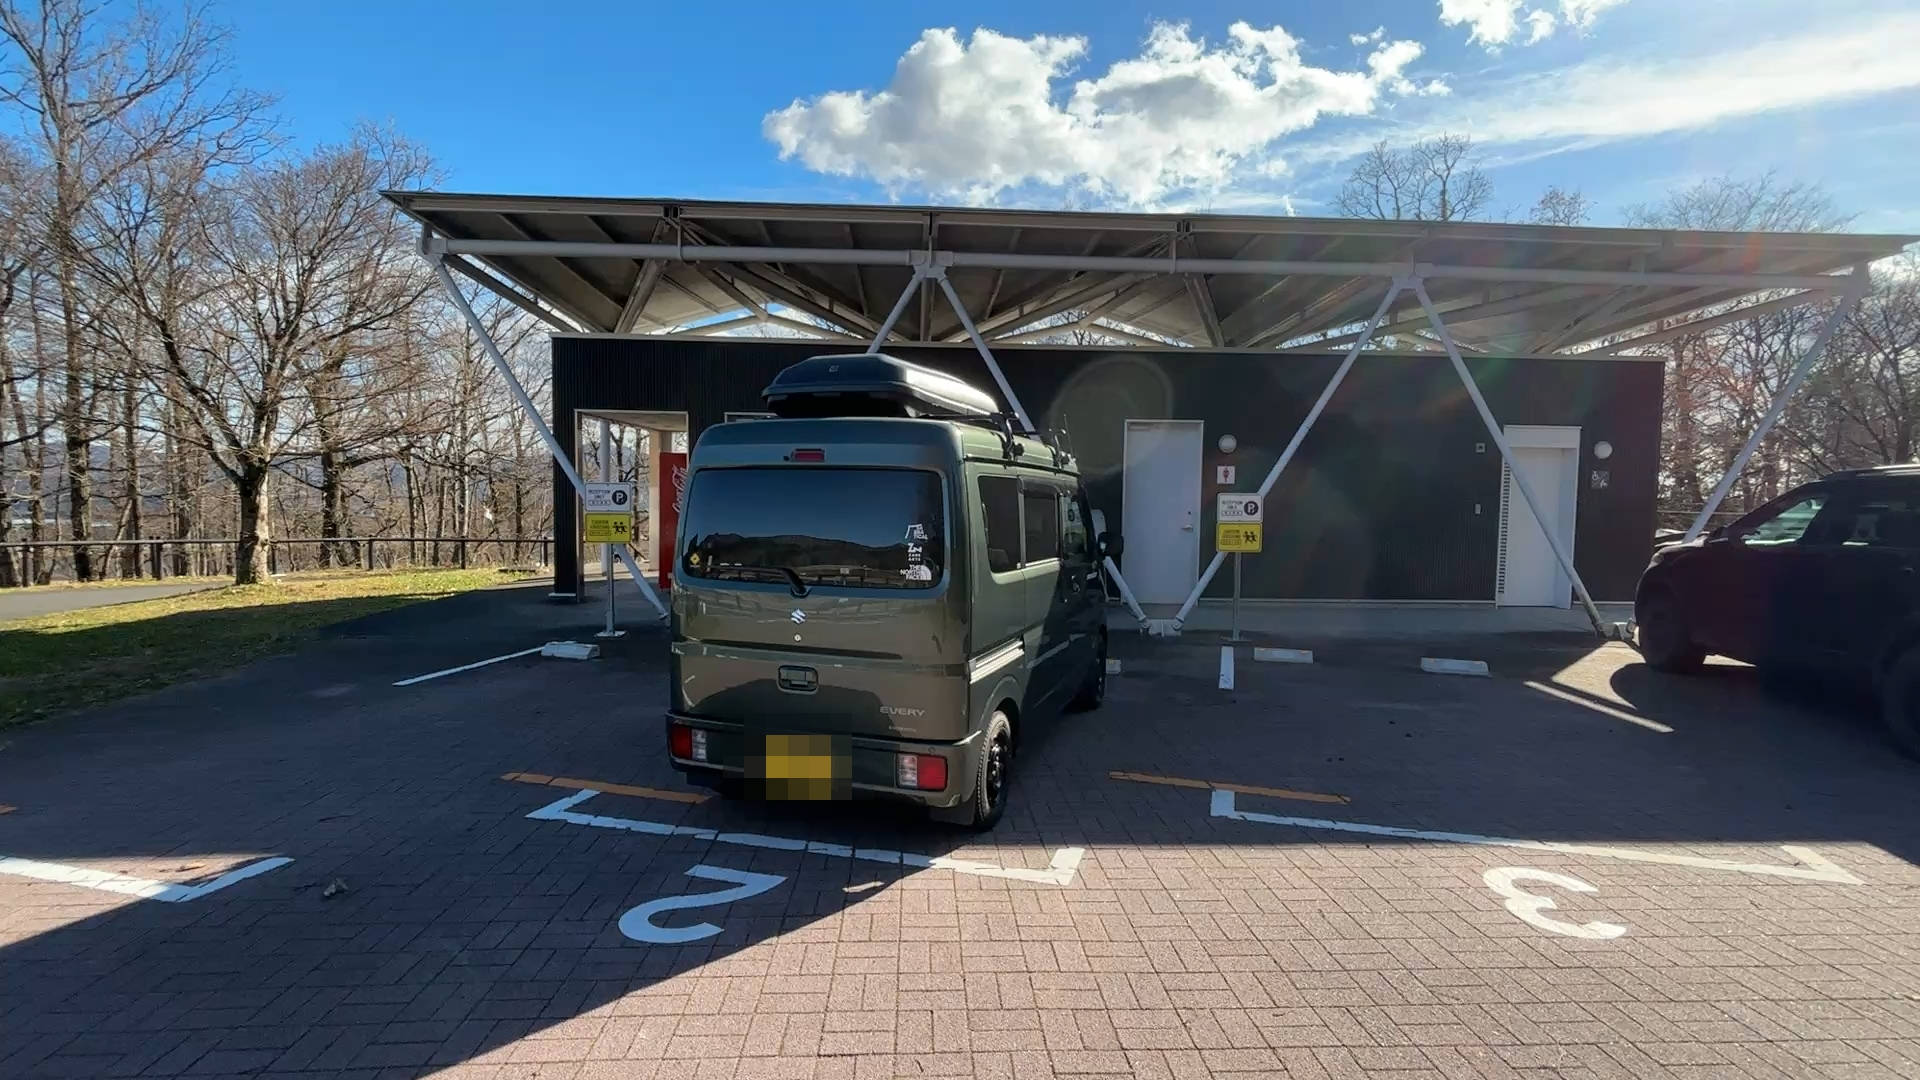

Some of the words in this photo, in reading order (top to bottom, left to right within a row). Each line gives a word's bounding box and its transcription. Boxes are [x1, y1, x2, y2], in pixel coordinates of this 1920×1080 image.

[879, 706, 926, 717] EVERY
[618, 864, 788, 945] 2
[1482, 866, 1627, 940] 3
